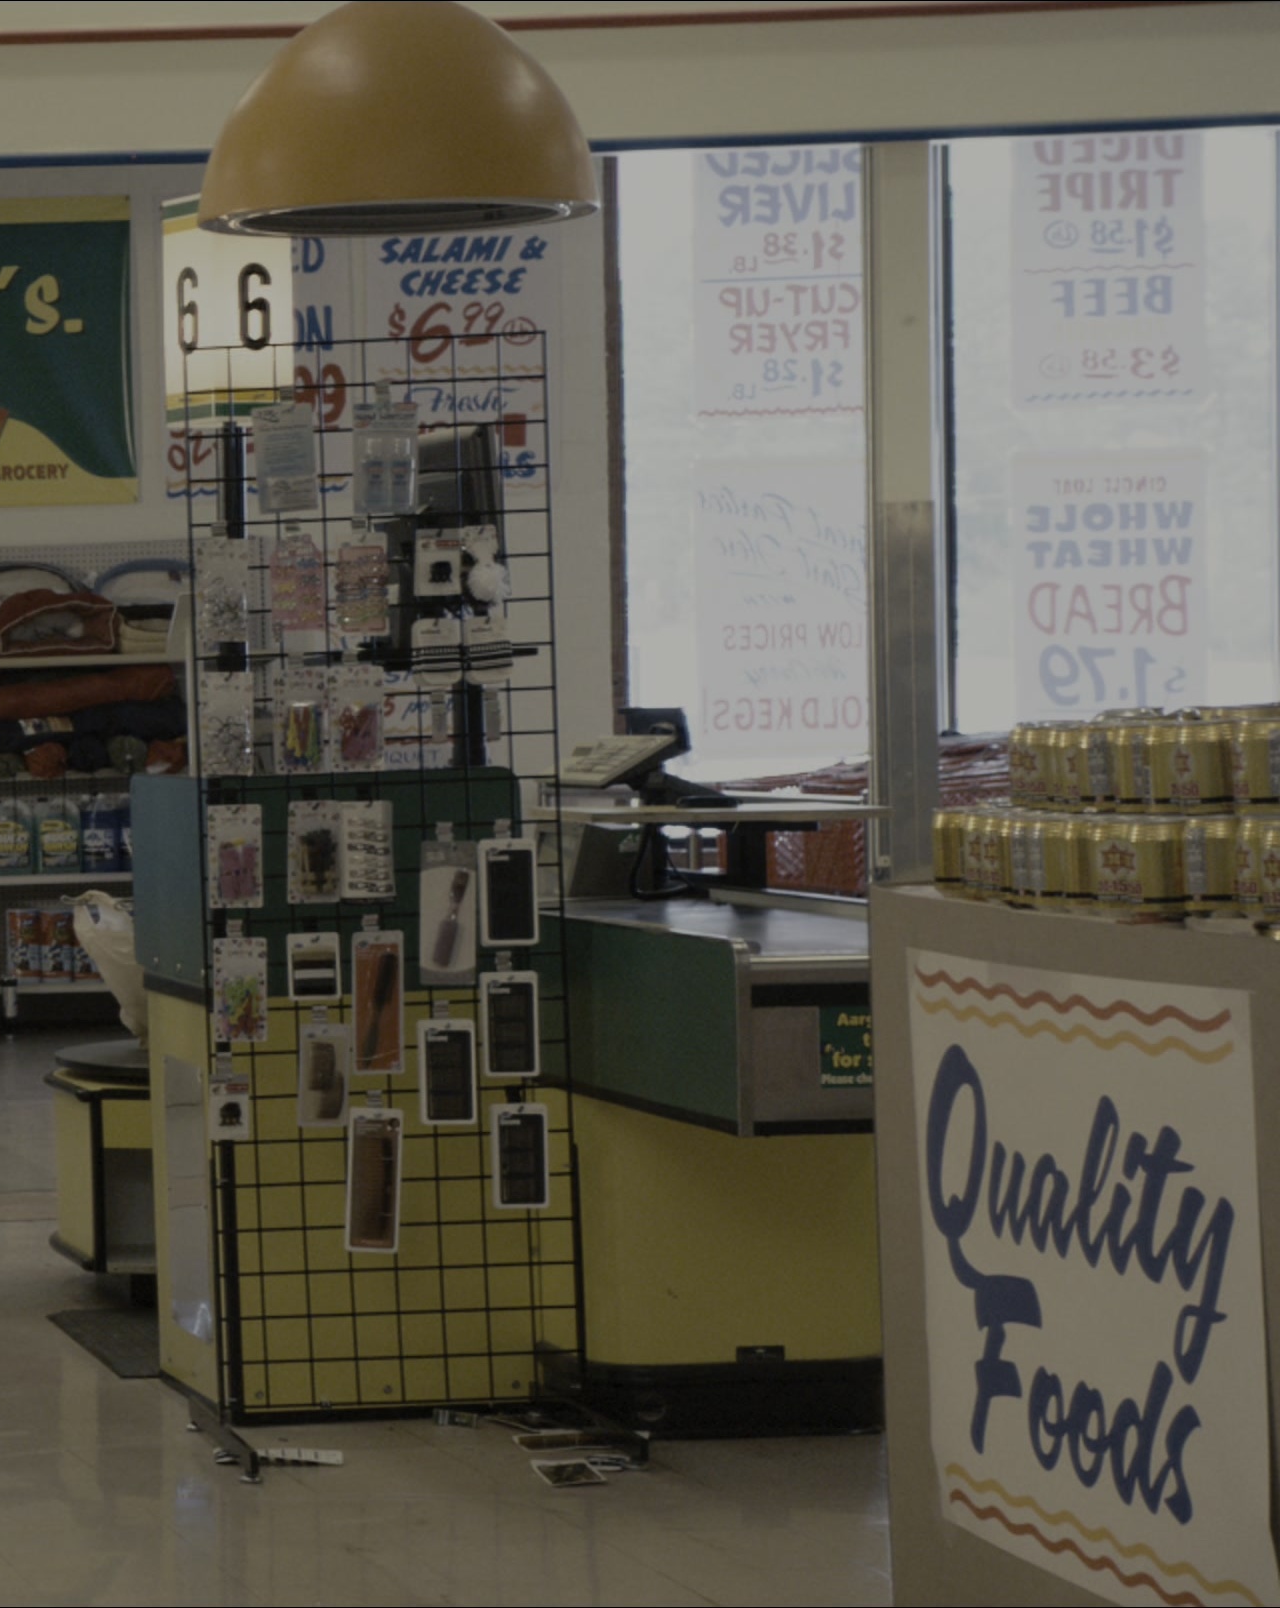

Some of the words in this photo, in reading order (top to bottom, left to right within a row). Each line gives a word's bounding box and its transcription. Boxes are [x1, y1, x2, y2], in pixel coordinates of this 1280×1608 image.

[378, 235, 514, 265] SALAMI
[518, 235, 548, 261] &
[399, 266, 528, 298] CHEESE
[176, 266, 199, 354] 6
[237, 262, 272, 351] 6
[831, 1050, 862, 1069] for
[926, 1042, 1237, 1386] Quality
[968, 1272, 1203, 1526] Foods
